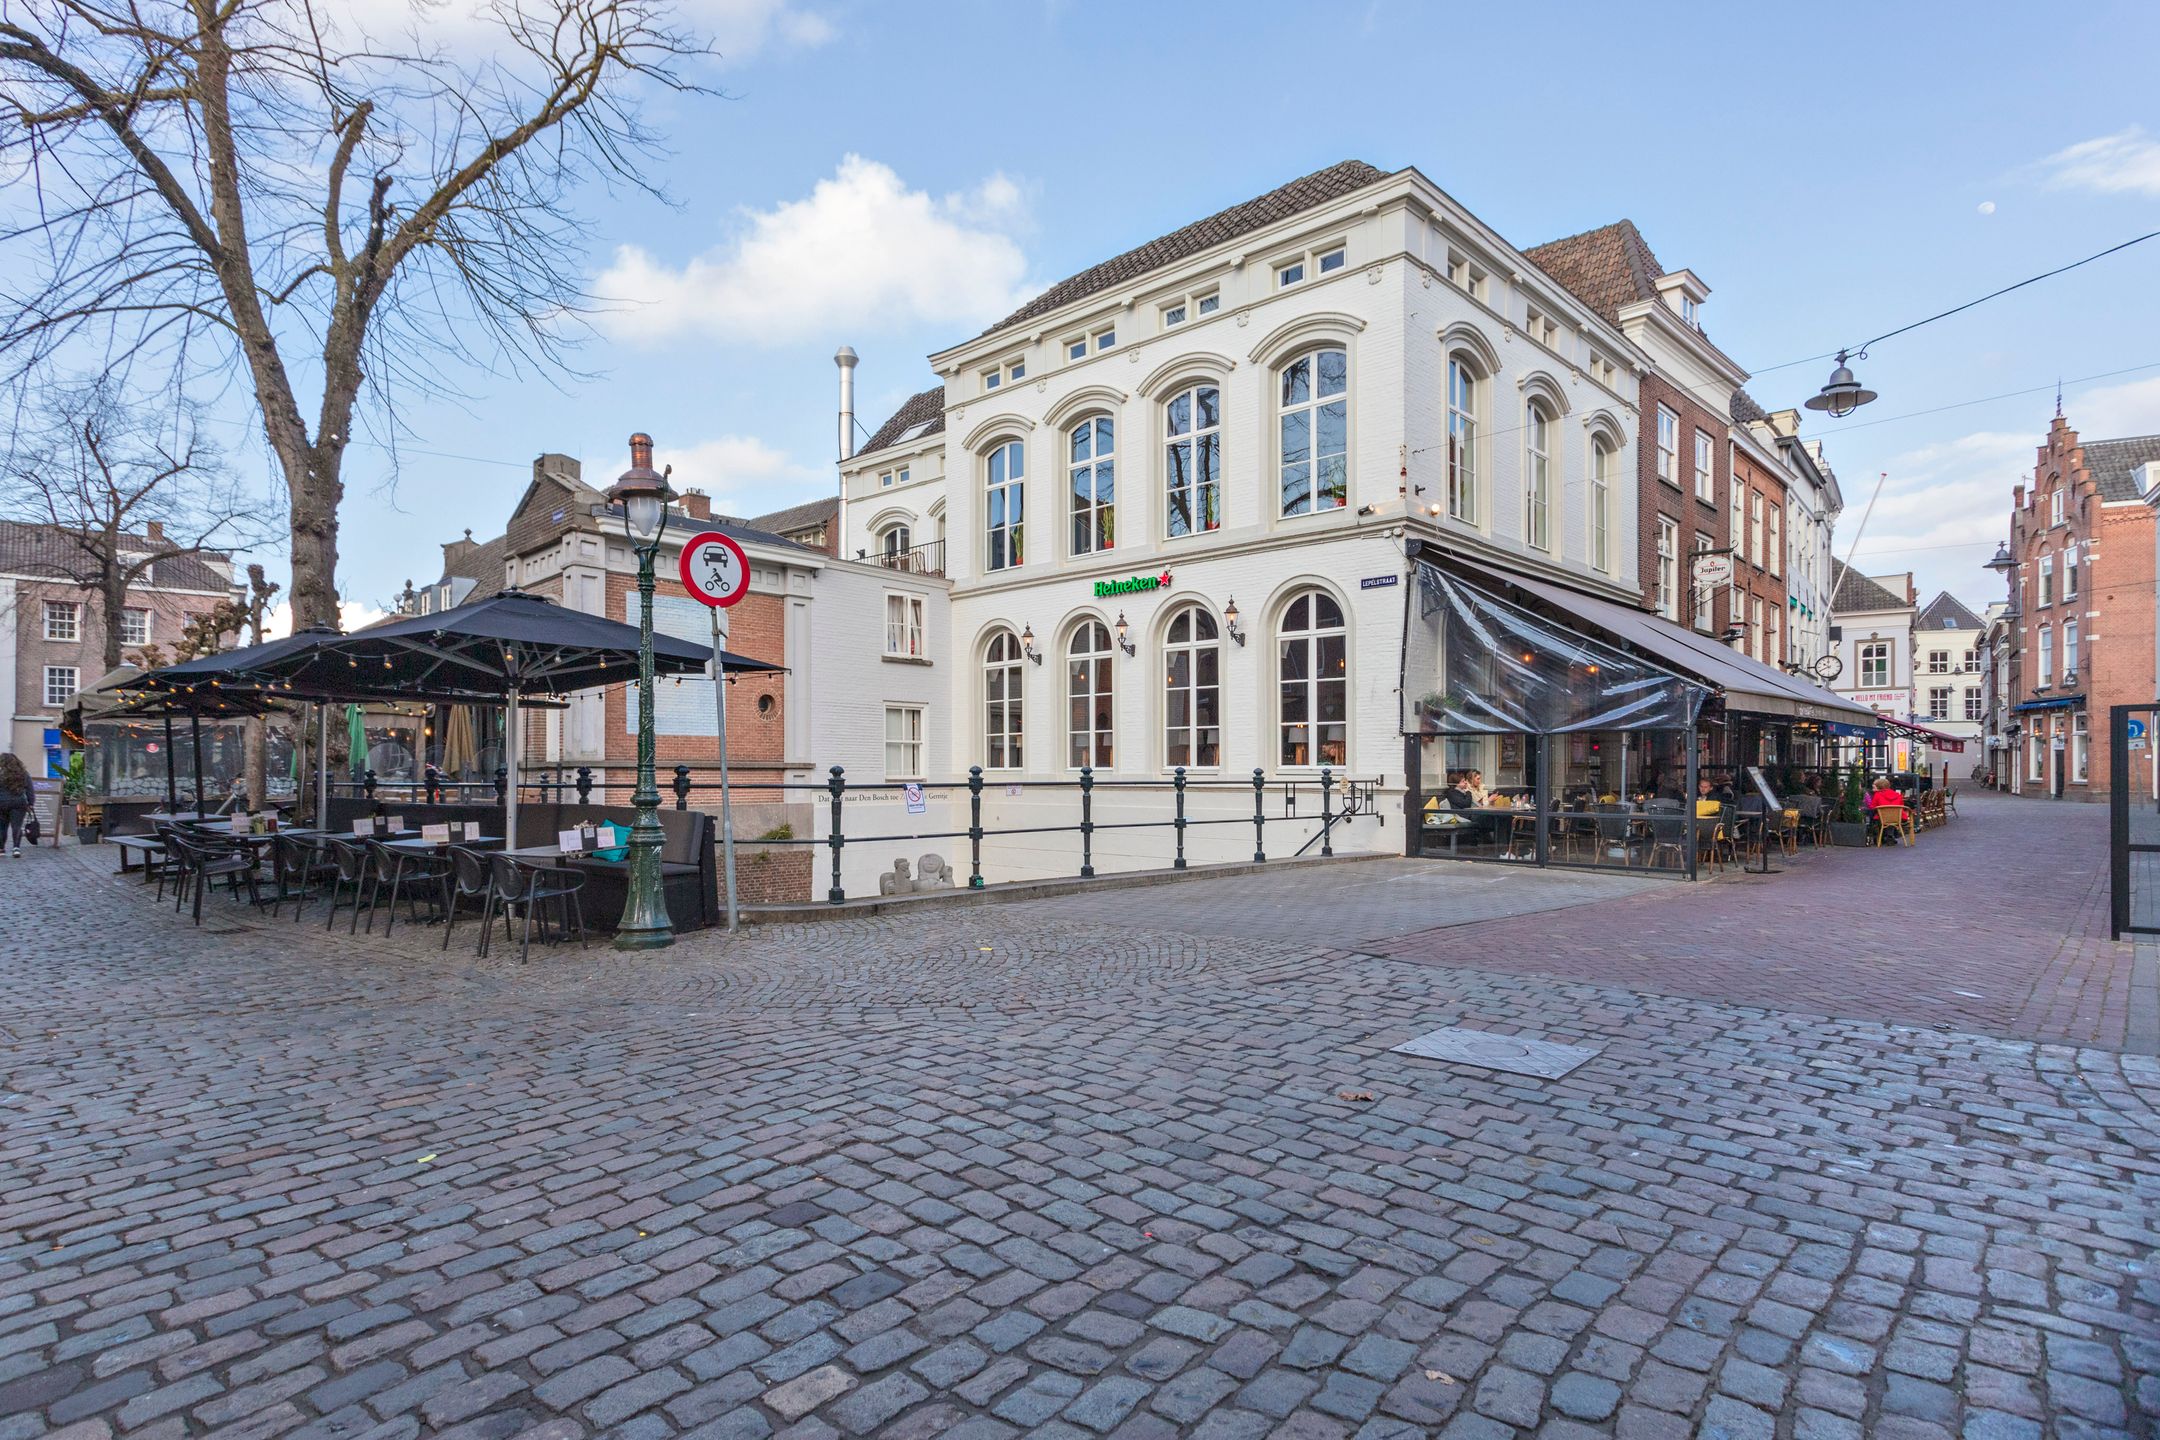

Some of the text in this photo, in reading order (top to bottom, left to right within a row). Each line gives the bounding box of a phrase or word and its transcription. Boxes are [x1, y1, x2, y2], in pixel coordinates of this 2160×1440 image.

[1094, 576, 1158, 597] Heineken
[1362, 576, 1396, 587] LEPELSTRAAT
[872, 793, 889, 801] Bosch
